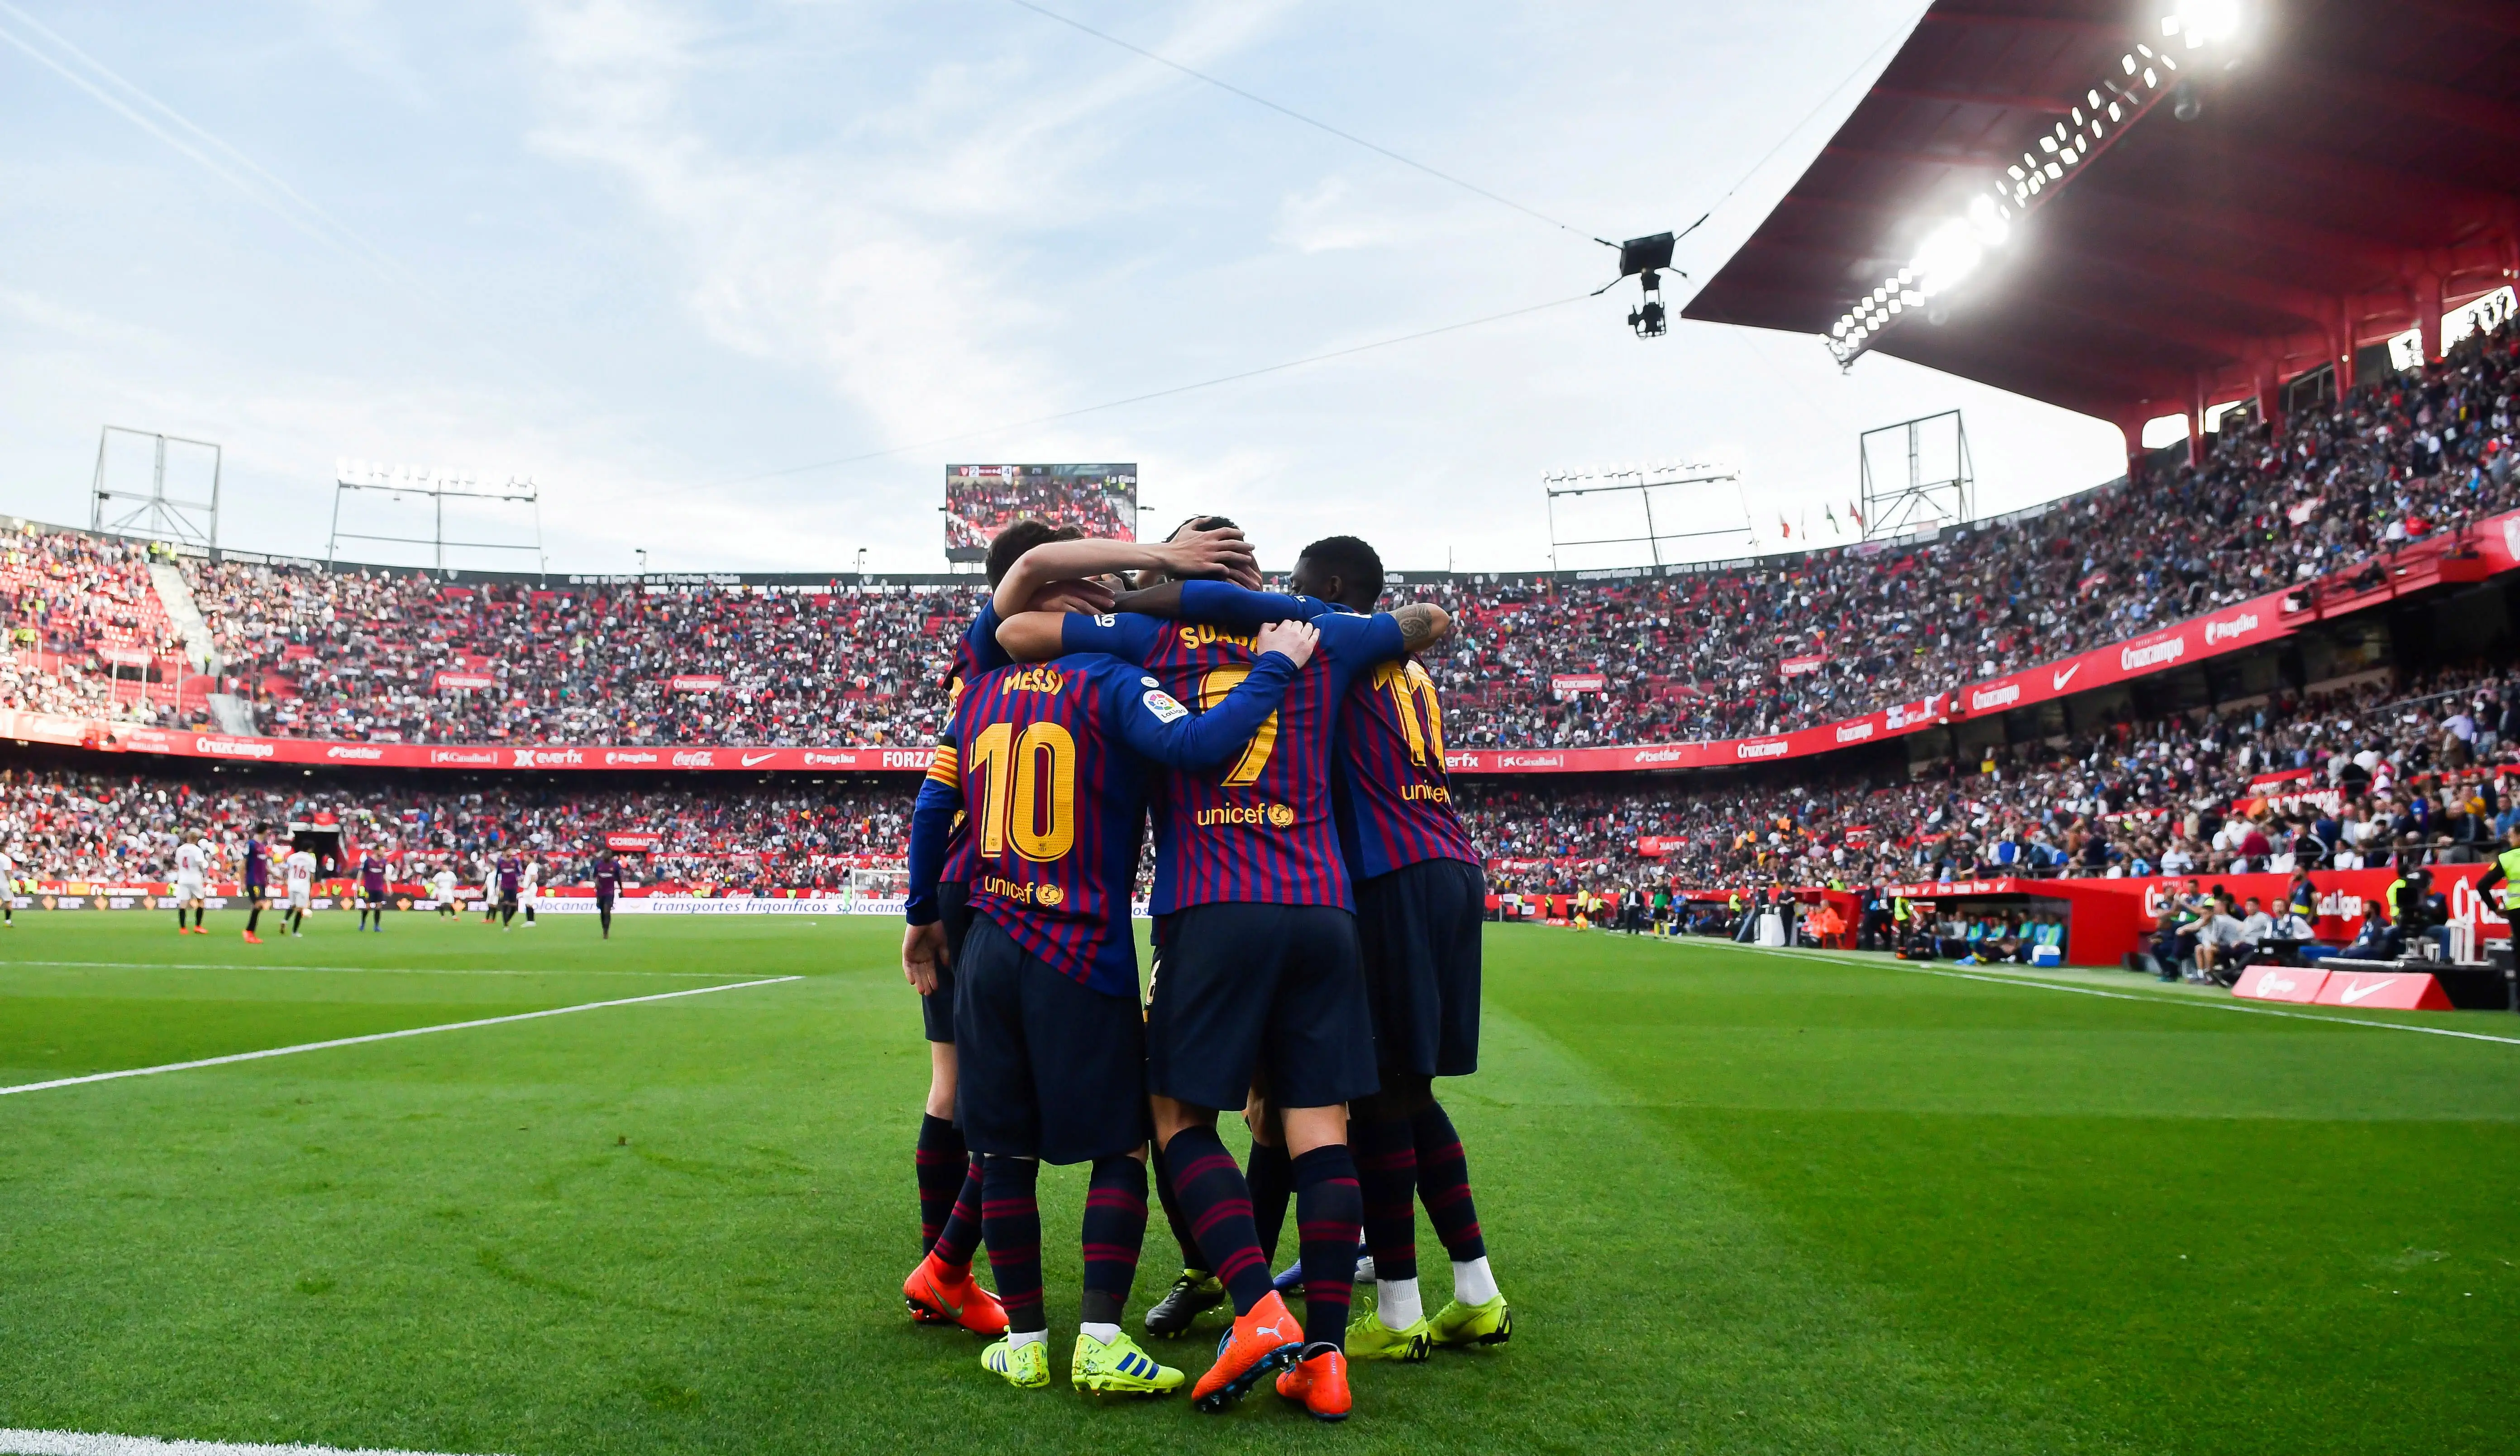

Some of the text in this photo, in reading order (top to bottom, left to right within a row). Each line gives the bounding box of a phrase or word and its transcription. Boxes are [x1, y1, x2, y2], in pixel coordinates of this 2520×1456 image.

[2121, 637, 2184, 670] Cruzcampo
[1002, 668, 1064, 696] MESSI
[1972, 684, 2020, 711] Cruzcampo
[1161, 709, 1186, 718] LaLiga
[196, 737, 274, 759] Cruzcampo
[1737, 740, 1788, 759] Cruzcampo
[816, 753, 856, 765] Playtika
[883, 751, 934, 768] FORZA
[1445, 753, 1479, 768] erfx
[969, 721, 1075, 862] 10
[1197, 802, 1266, 826] unicef
[293, 864, 307, 879] 16
[984, 875, 1035, 904] unicef
[653, 902, 741, 913] transportes
[836, 900, 906, 912] solocana
